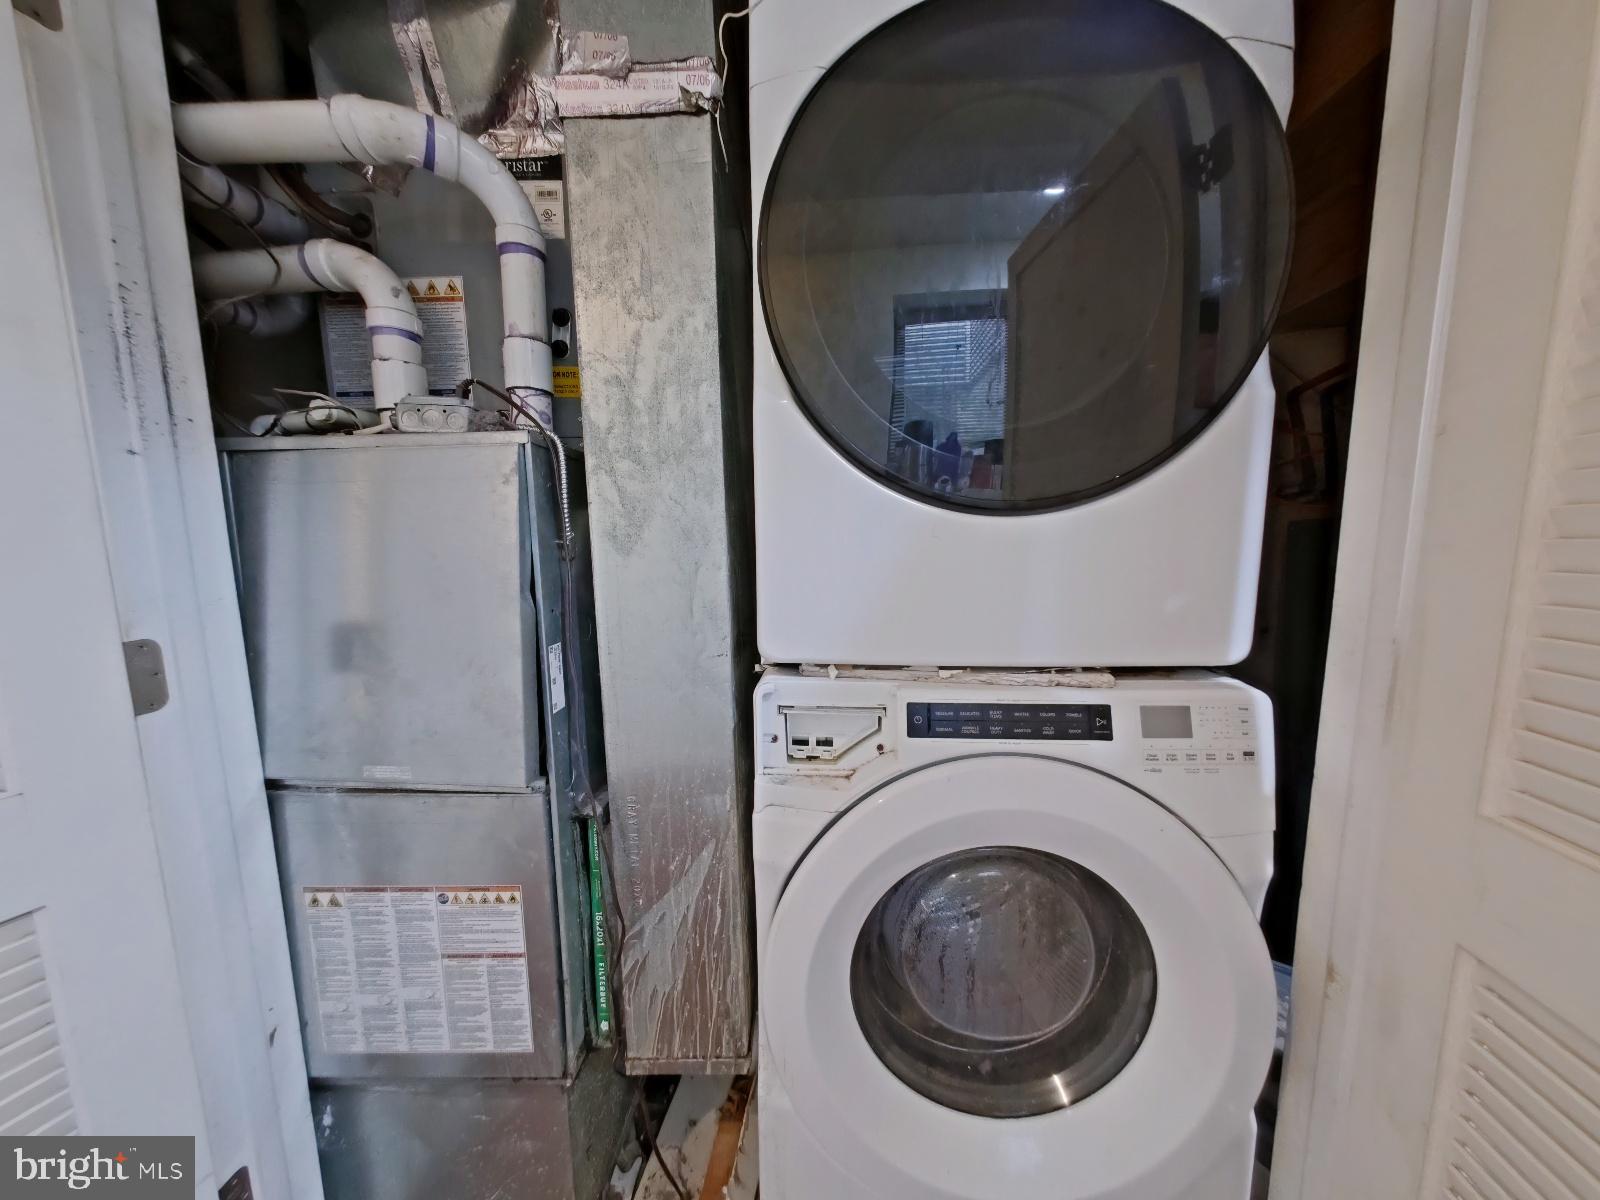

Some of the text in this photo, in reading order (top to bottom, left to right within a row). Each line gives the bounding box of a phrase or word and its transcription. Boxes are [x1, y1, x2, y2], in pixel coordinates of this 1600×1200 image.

[686, 74, 711, 87] 07/06
[505, 159, 544, 172] ristar
[598, 962, 607, 1008] FILTERBUY
